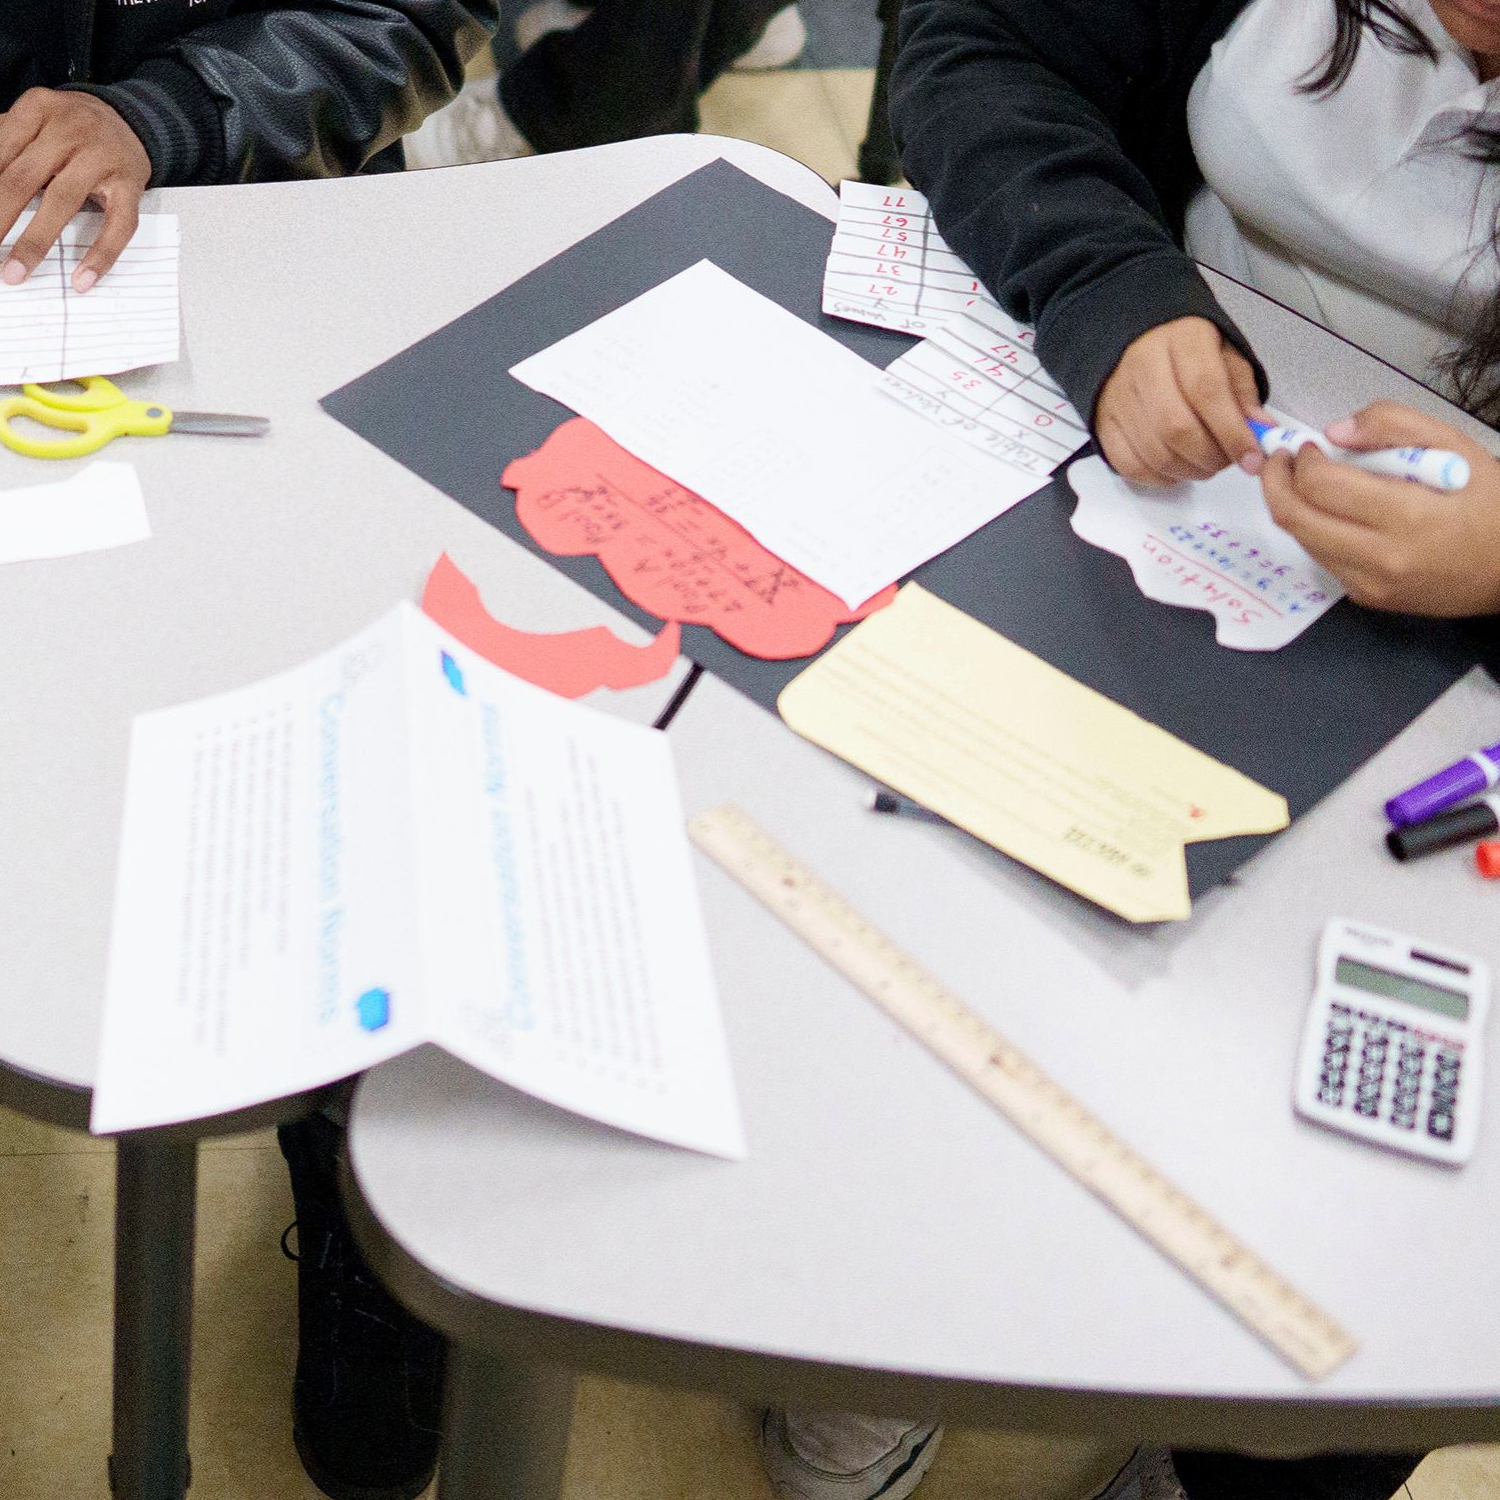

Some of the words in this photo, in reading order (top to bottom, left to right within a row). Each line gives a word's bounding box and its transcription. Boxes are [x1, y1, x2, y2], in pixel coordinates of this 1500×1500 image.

[883, 196, 906, 208] 77
[882, 216, 908, 227] 67
[882, 229, 908, 242] 57
[877, 244, 907, 259] 47
[876, 263, 901, 276] 37
[868, 284, 898, 296] 27
[989, 344, 1019, 364] 47
[973, 357, 1005, 377] 41
[950, 370, 983, 389] 35
